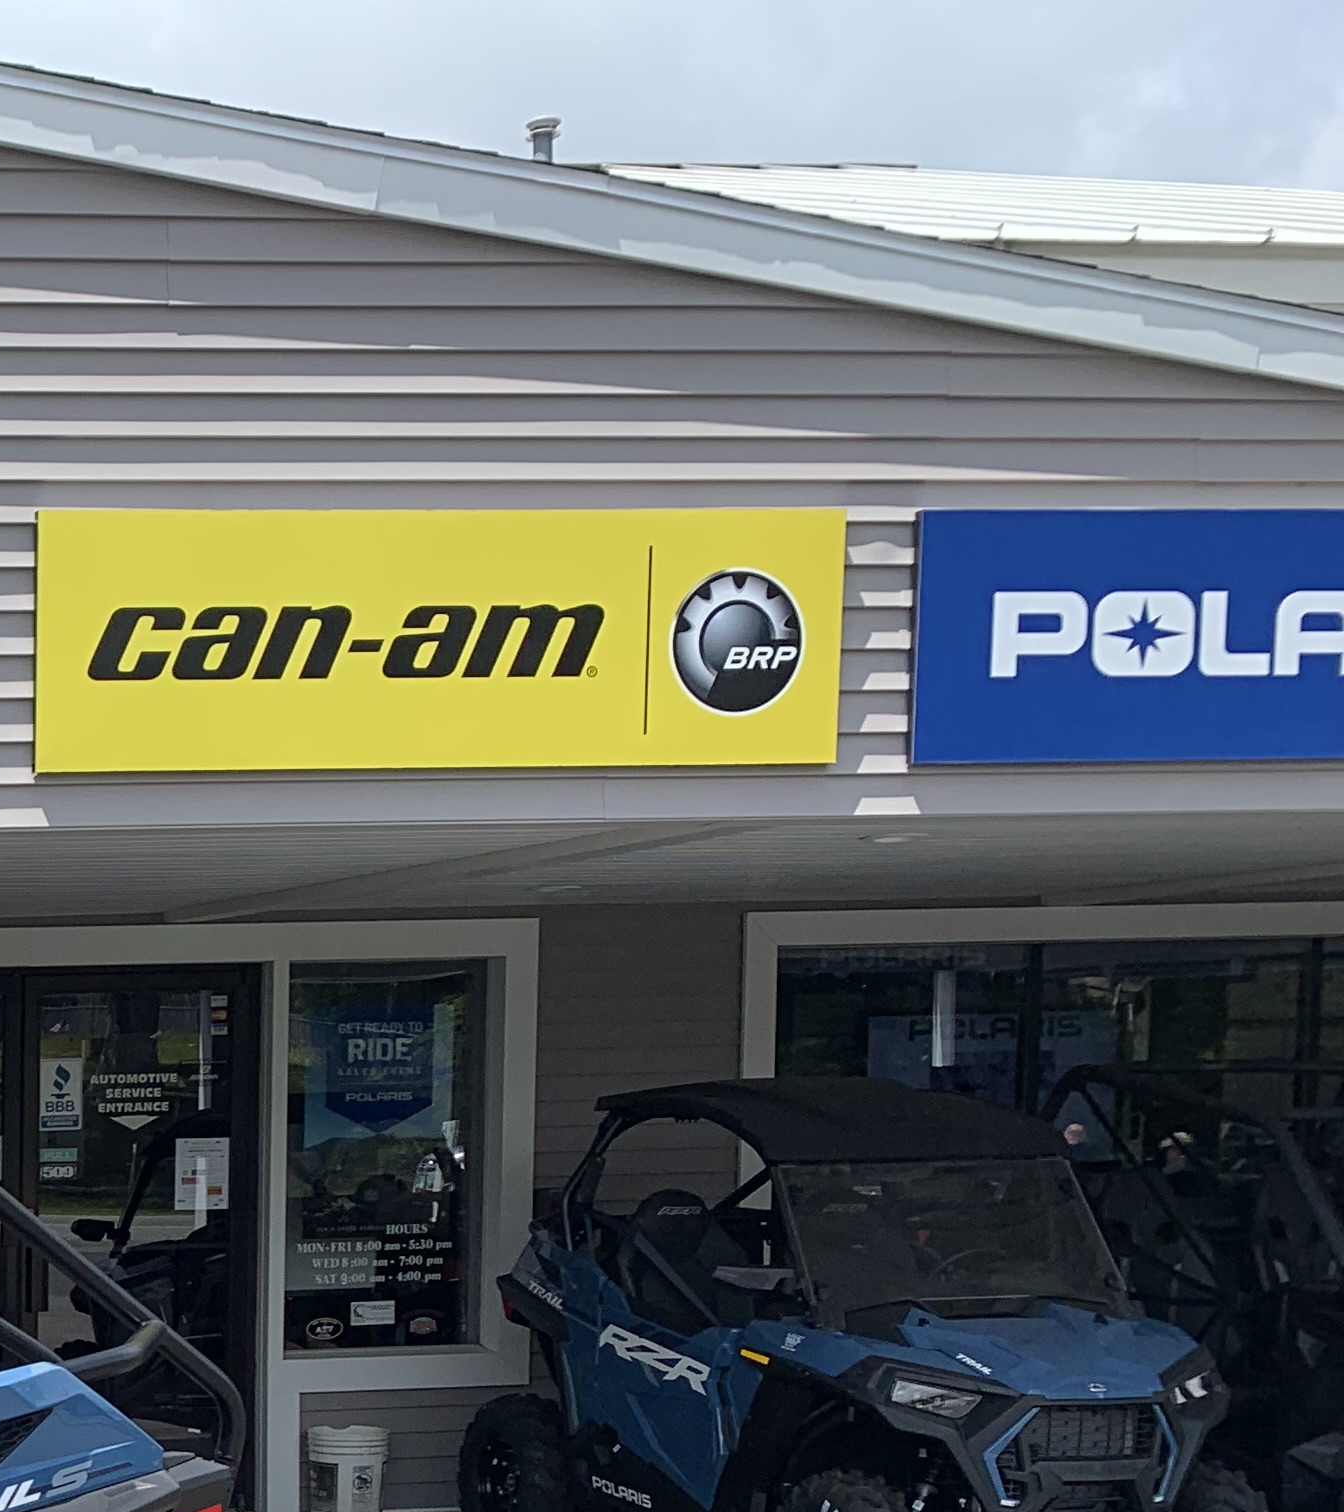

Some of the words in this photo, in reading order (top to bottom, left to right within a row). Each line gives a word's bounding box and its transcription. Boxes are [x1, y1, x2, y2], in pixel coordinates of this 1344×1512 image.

[87, 603, 605, 681] can-am
[723, 645, 799, 671] BRP
[338, 1023, 362, 1034] GET
[347, 1037, 413, 1063] RIDE
[90, 1073, 178, 1085] AUTOMOTIVE
[105, 1087, 162, 1099] SERVICE
[345, 1091, 413, 1102] POLARIS
[45, 1100, 75, 1112] BBB
[97, 1101, 170, 1113] ENTRANCE
[42, 1166, 74, 1178] 509
[385, 1223, 428, 1235] HOURS
[435, 1240, 453, 1251] pm
[312, 1257, 339, 1269] WED
[399, 1255, 423, 1266] 7:00
[426, 1257, 443, 1267] pm
[314, 1273, 337, 1285] SAT
[396, 1271, 421, 1282] 4:00
[424, 1272, 442, 1283] pm
[528, 1280, 563, 1310] TRAIL
[599, 1324, 711, 1396] RZR
[46, 1460, 93, 1498] S
[592, 1475, 652, 1509] POLARIS
